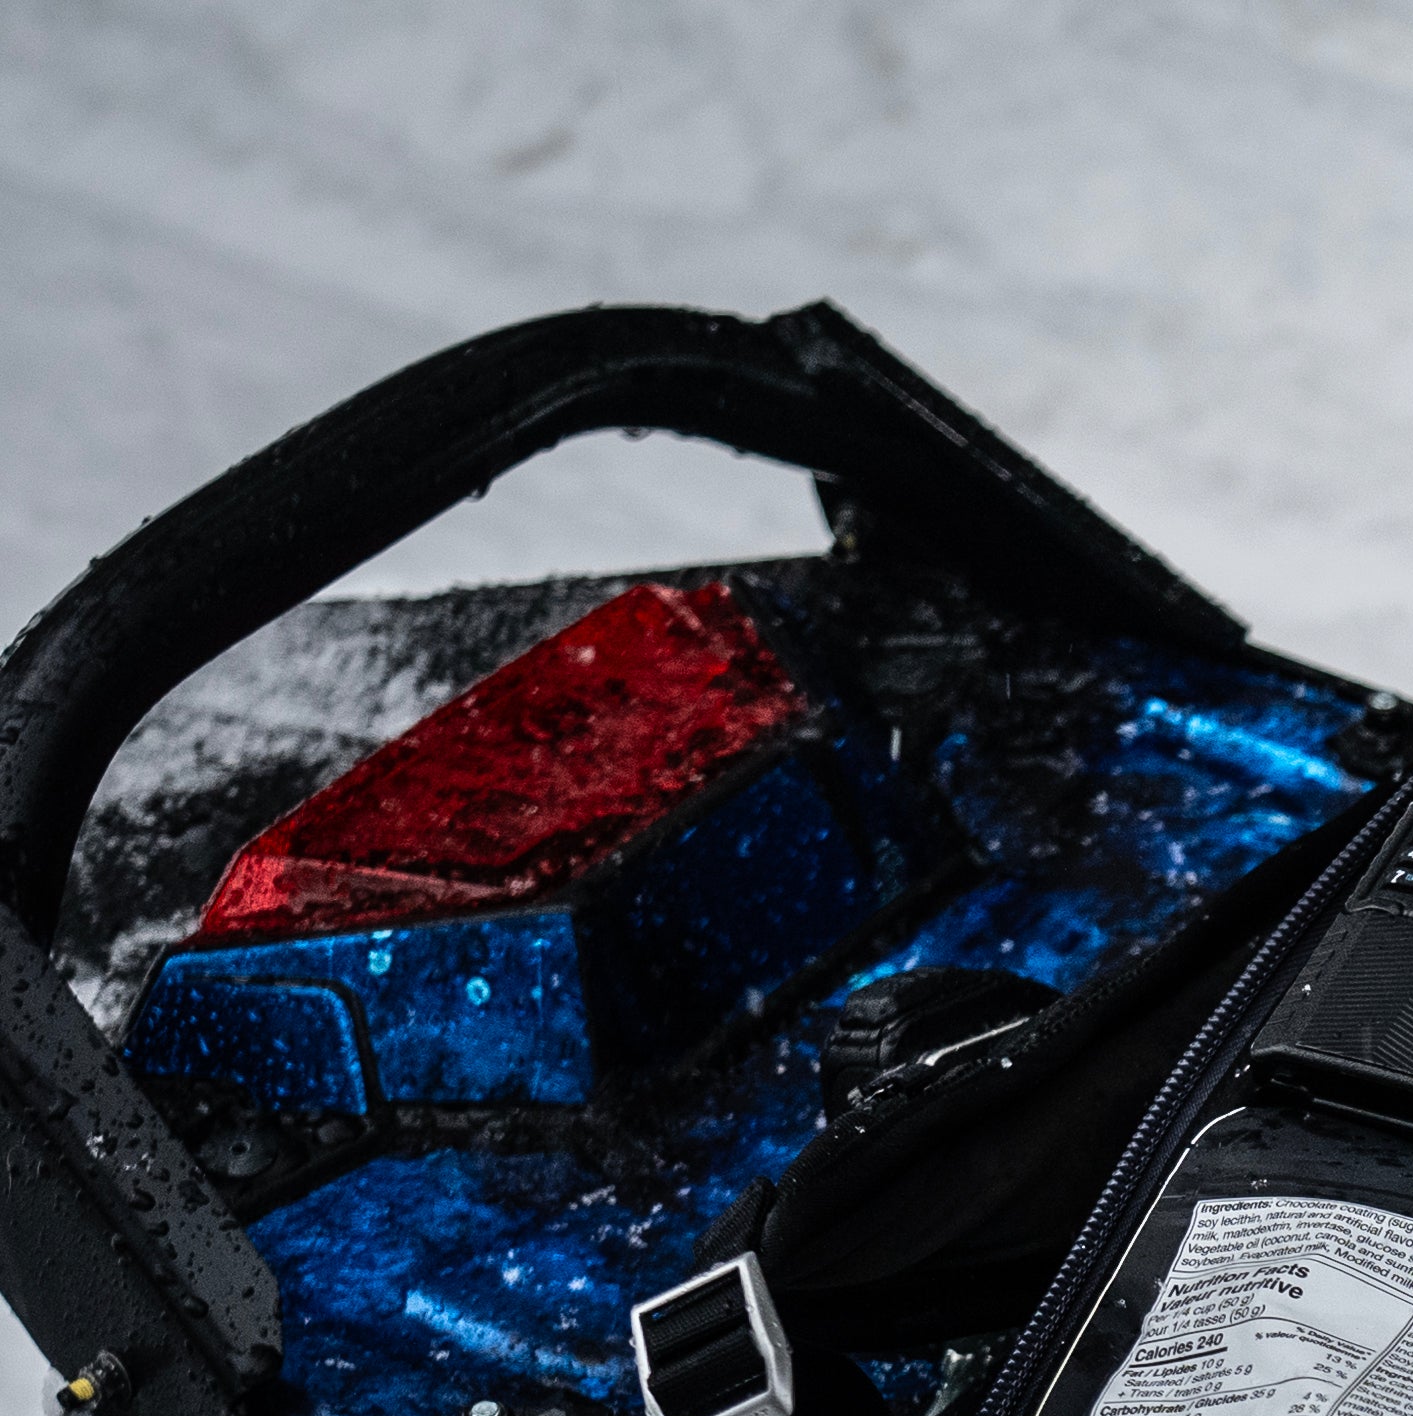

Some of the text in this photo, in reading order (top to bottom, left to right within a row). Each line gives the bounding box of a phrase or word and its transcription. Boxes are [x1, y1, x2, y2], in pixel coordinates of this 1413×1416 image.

[1390, 869, 1406, 884] 7
[1196, 1217, 1219, 1231] soy
[1220, 1212, 1263, 1227] lecithin,
[1265, 1210, 1306, 1221] natural
[1307, 1211, 1333, 1220] and
[1333, 1211, 1383, 1238] artificial
[1200, 1200, 1273, 1214] Ingredients:
[1275, 1199, 1338, 1211] Chocolate
[1339, 1203, 1387, 1224] coating
[1187, 1240, 1245, 1257] Vegetable
[1245, 1236, 1260, 1250] oil
[1314, 1231, 1358, 1251] canola
[1357, 1248, 1385, 1263] and
[1191, 1230, 1220, 1243] milk,
[1223, 1222, 1292, 1239] maltodextrin,
[1296, 1220, 1353, 1239] invertase,
[1356, 1233, 1408, 1260] glucose
[1333, 1248, 1391, 1279] Modified
[1167, 1263, 1311, 1298] Nutrition Facts
[1160, 1277, 1305, 1313] Valeur nutritive
[1192, 1302, 1217, 1316] cup
[1217, 1295, 1240, 1313] (50
[1240, 1292, 1255, 1308] g)
[1172, 1316, 1191, 1333] 1/4
[1192, 1312, 1227, 1329] tasse
[1228, 1307, 1250, 1325] (50
[1250, 1304, 1266, 1319] g)
[1135, 1332, 1225, 1363] Calories 240
[1325, 1352, 1343, 1364] 13
[1121, 1369, 1146, 1378] Fat
[1153, 1364, 1198, 1378] Lipides
[1200, 1359, 1213, 1371] 10
[1312, 1362, 1333, 1375] 25
[1193, 1393, 1249, 1409] Glucides
